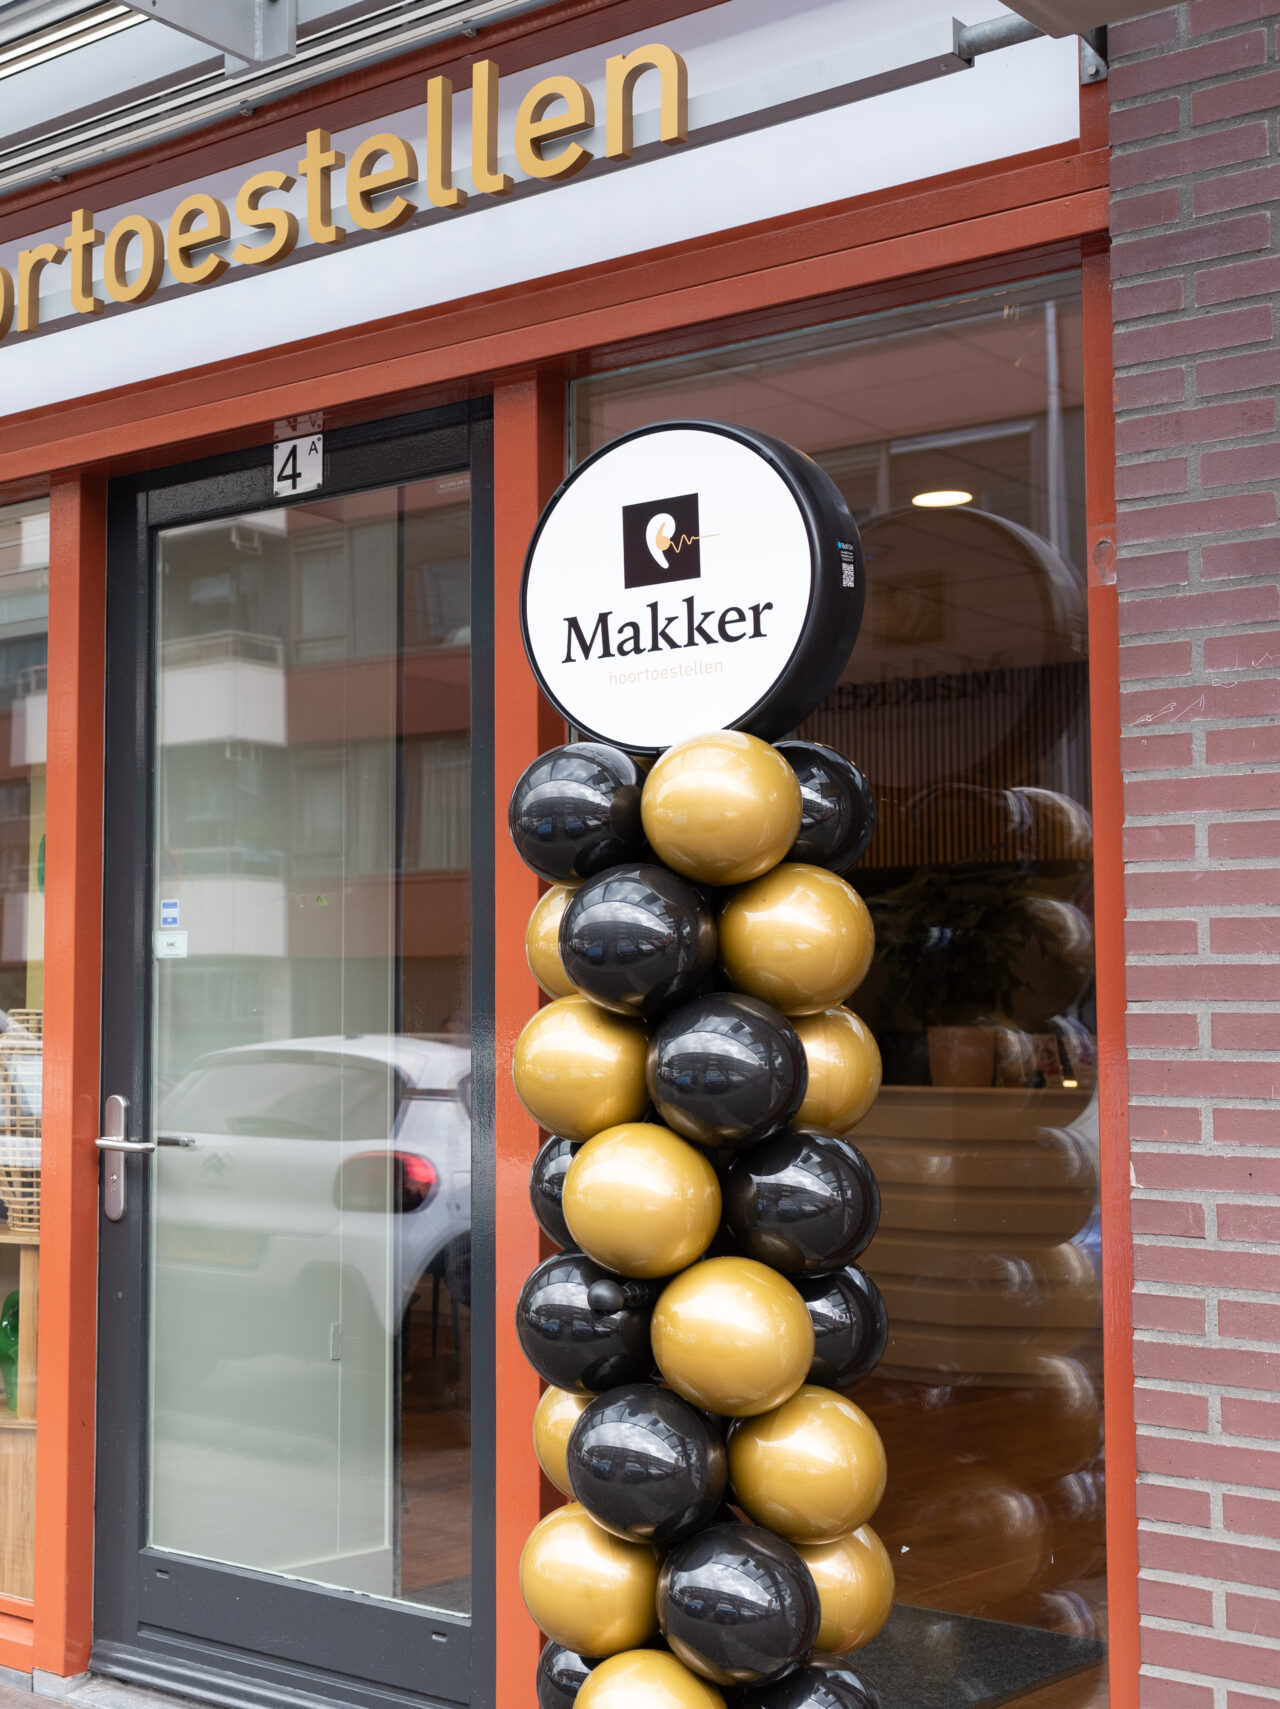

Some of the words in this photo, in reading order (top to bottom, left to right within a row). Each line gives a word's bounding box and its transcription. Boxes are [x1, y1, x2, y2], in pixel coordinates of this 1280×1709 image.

[277, 444, 302, 490] 4
[308, 440, 319, 456] A
[561, 595, 774, 664] Makker
[608, 660, 723, 687] hoortoestellen
